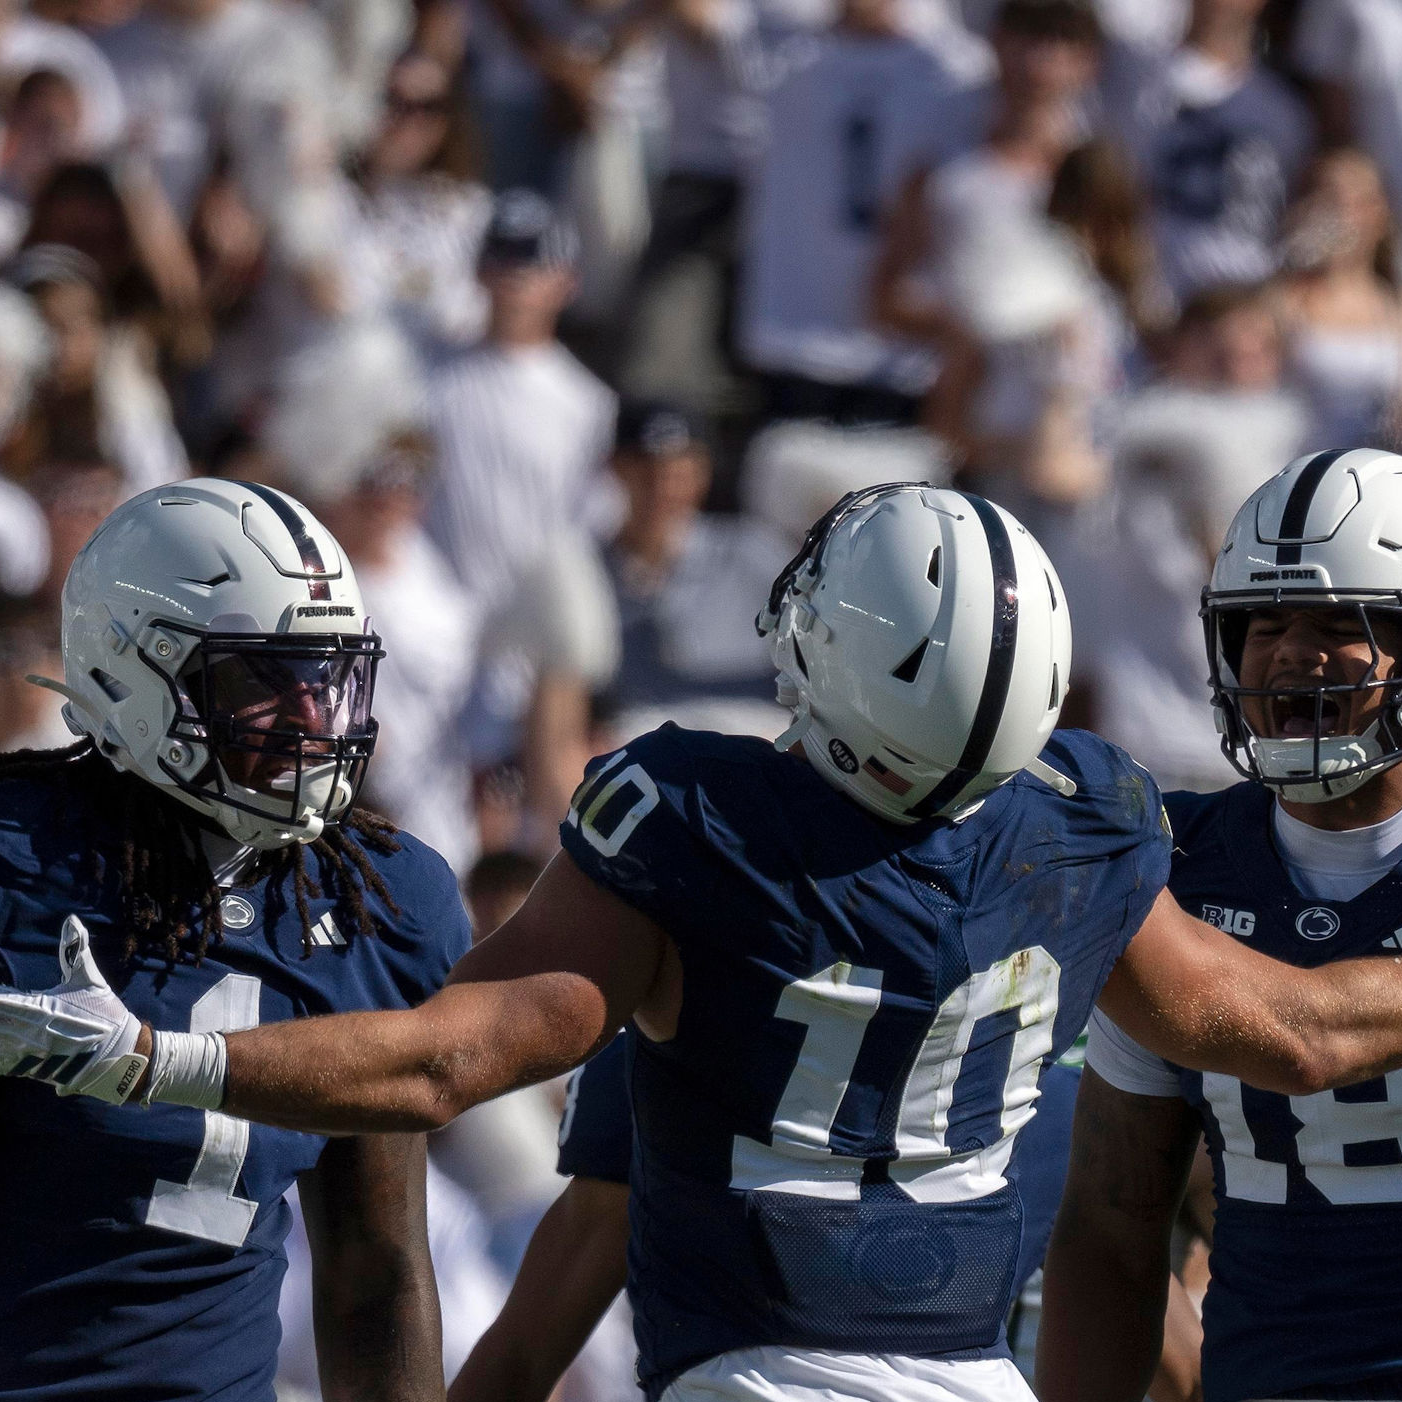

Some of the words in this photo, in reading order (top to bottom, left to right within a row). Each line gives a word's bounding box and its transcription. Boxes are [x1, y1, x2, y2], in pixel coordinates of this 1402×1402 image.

[1281, 569, 1317, 580] STATE
[297, 606, 327, 618] PENN
[831, 740, 856, 770] WJS
[116, 1060, 141, 1097] ADIZERO
[730, 945, 1062, 1204] 10
